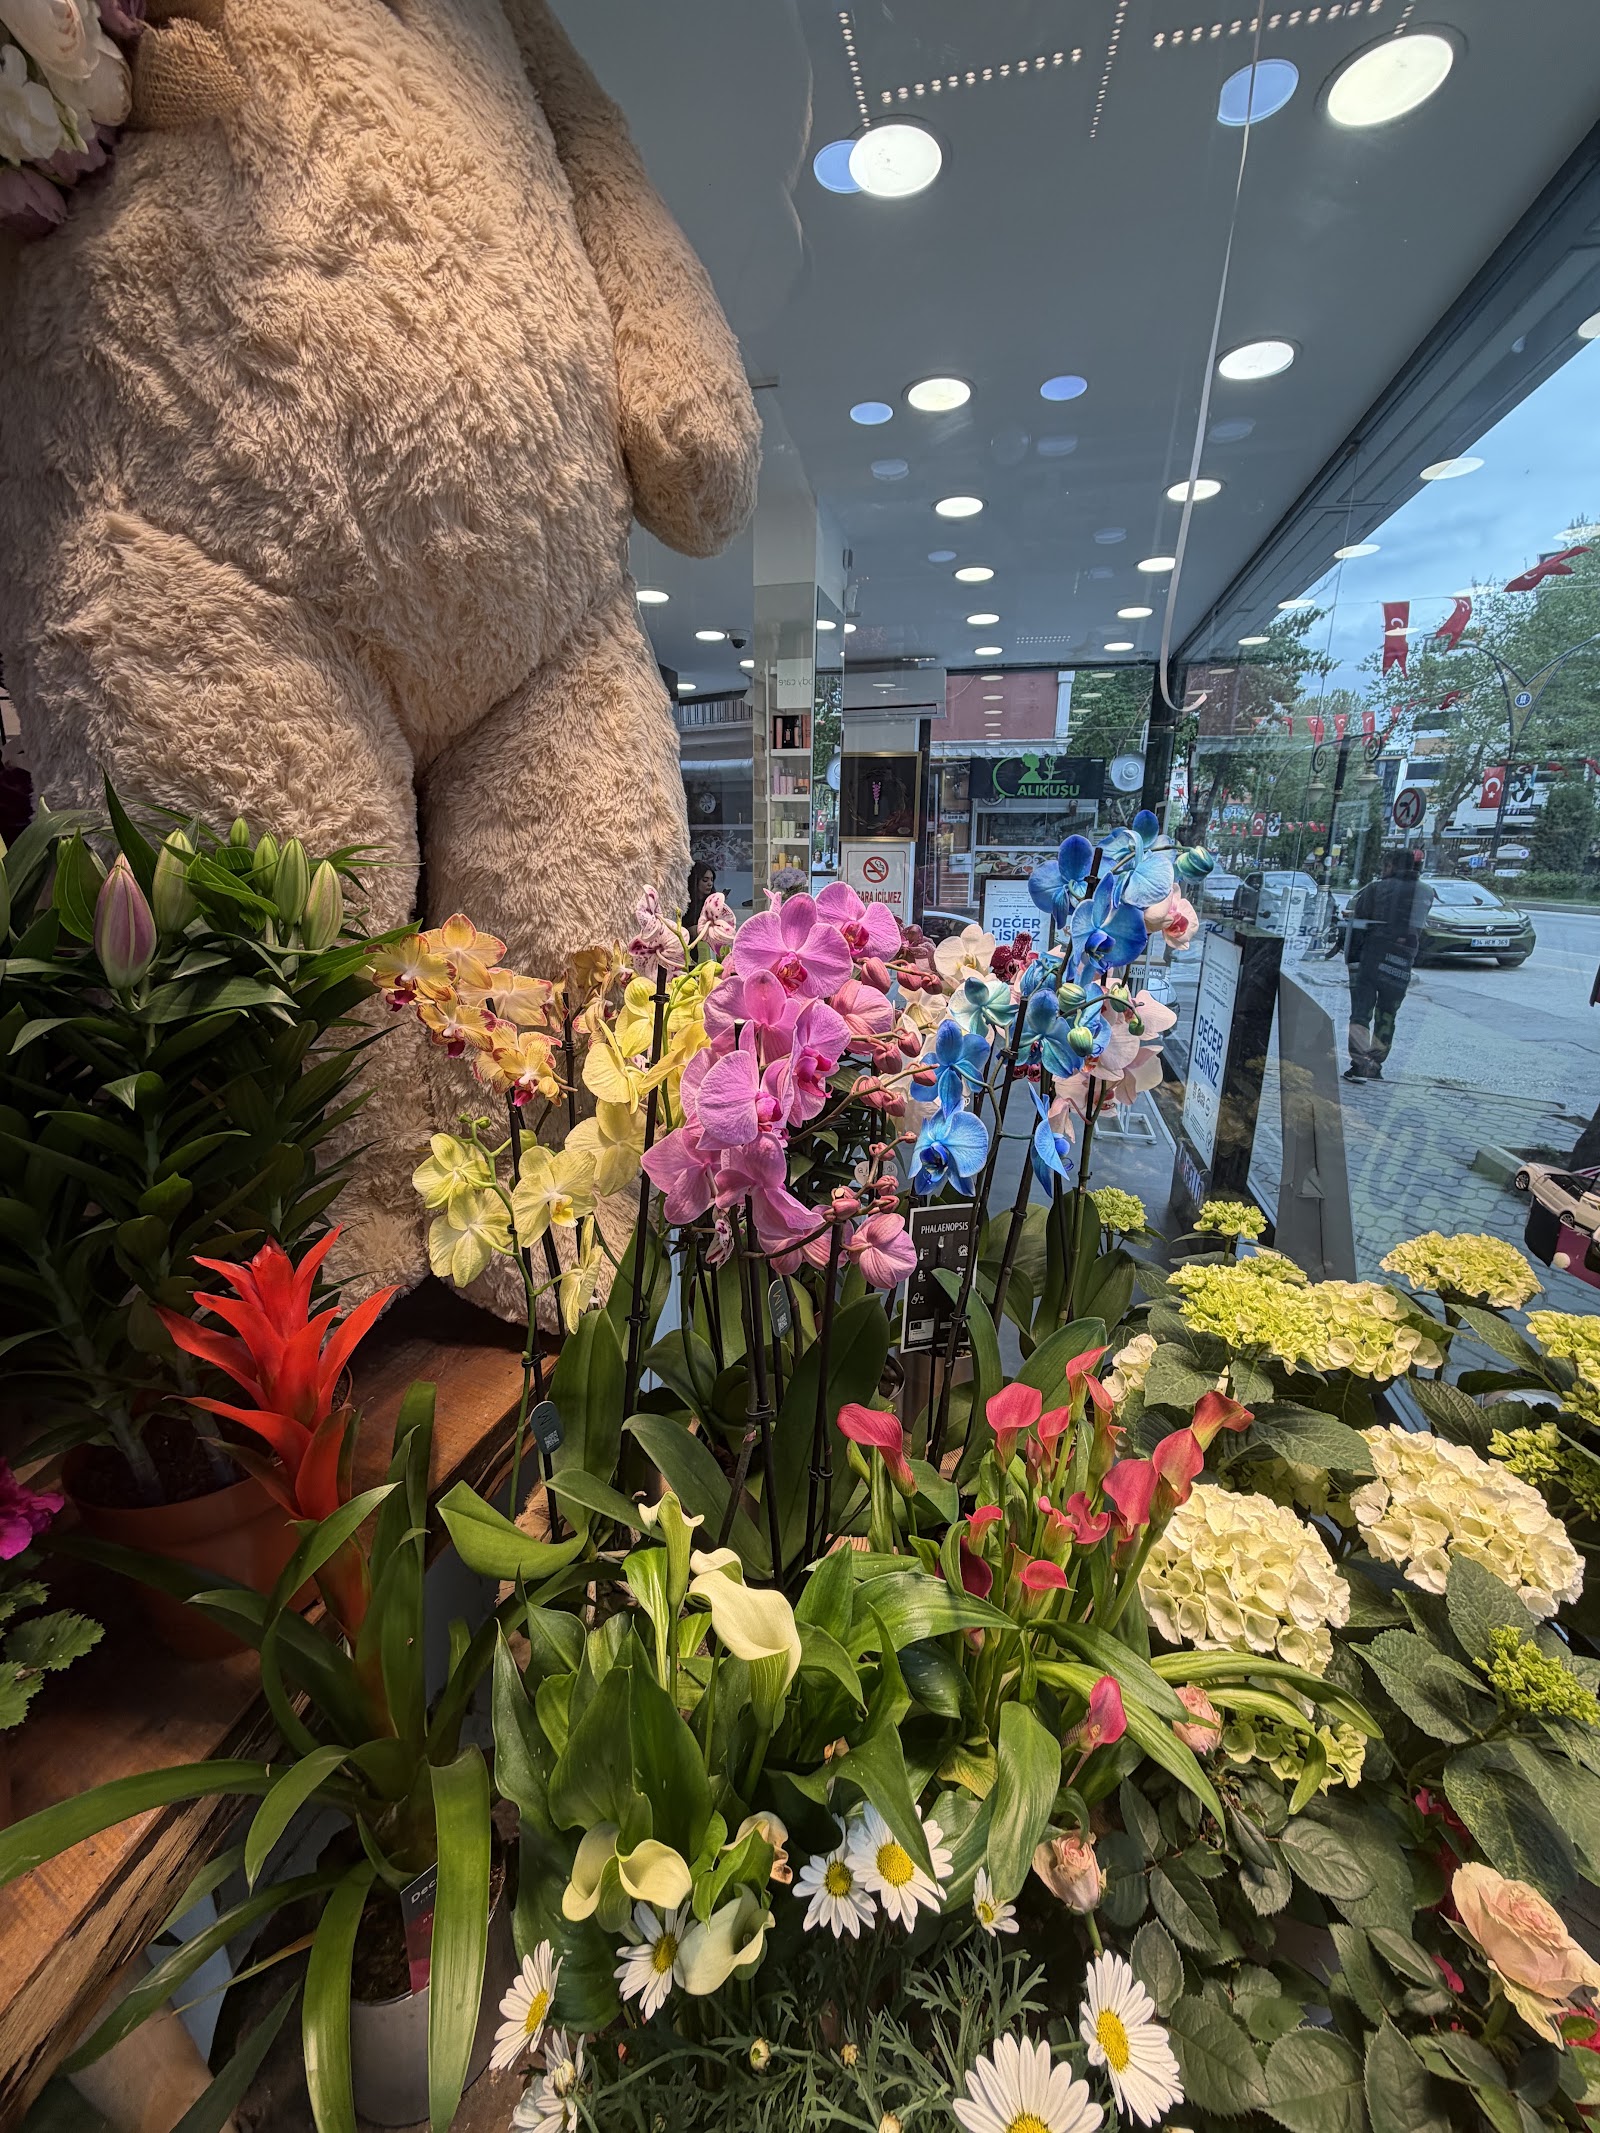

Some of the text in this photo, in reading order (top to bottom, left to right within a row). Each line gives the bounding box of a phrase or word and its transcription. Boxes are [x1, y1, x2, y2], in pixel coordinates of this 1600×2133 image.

[992, 915, 1041, 929] DEĞER
[991, 928, 1041, 942] İSİZ
[1198, 1014, 1224, 1058] DEĞER
[1195, 1040, 1220, 1088] LİSİNİZ
[920, 1221, 969, 1235] PHALAENOPSIS
[411, 1879, 438, 1904] Dec
